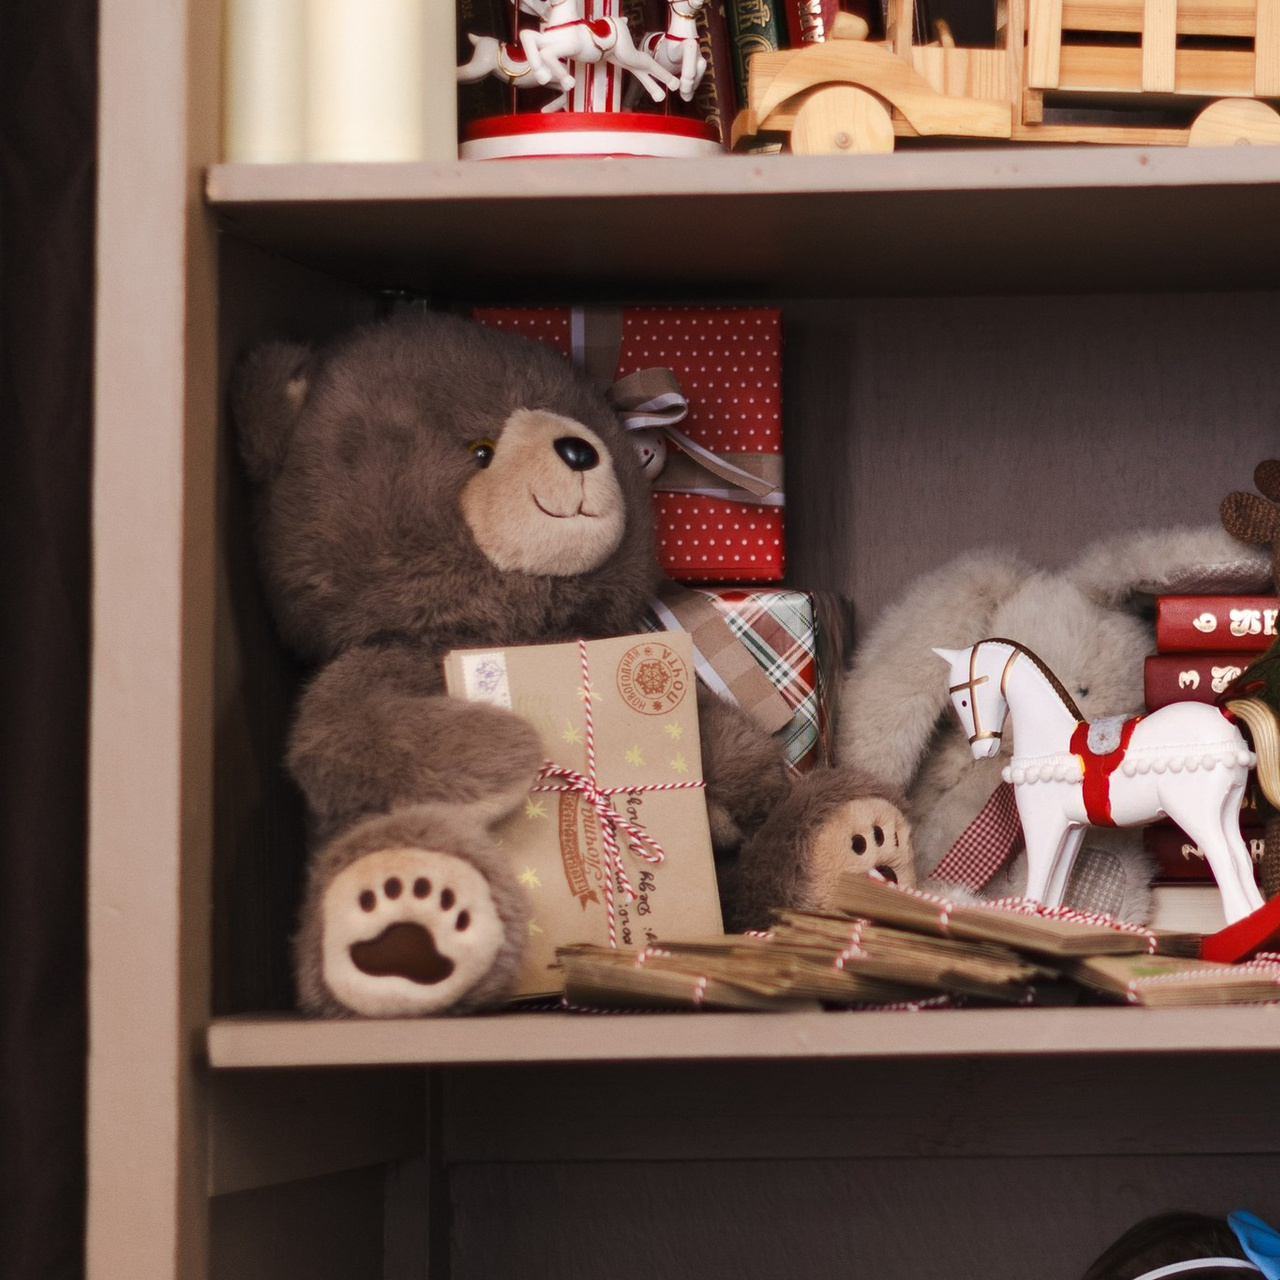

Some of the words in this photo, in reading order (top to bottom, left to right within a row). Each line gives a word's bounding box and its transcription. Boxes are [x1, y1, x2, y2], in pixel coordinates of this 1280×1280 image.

[620, 648, 647, 711] НОВОГОДНЯЯ
[662, 648, 684, 704] ПОЧТА
[581, 808, 602, 880] Почта
[636, 871, 656, 916] Деду
